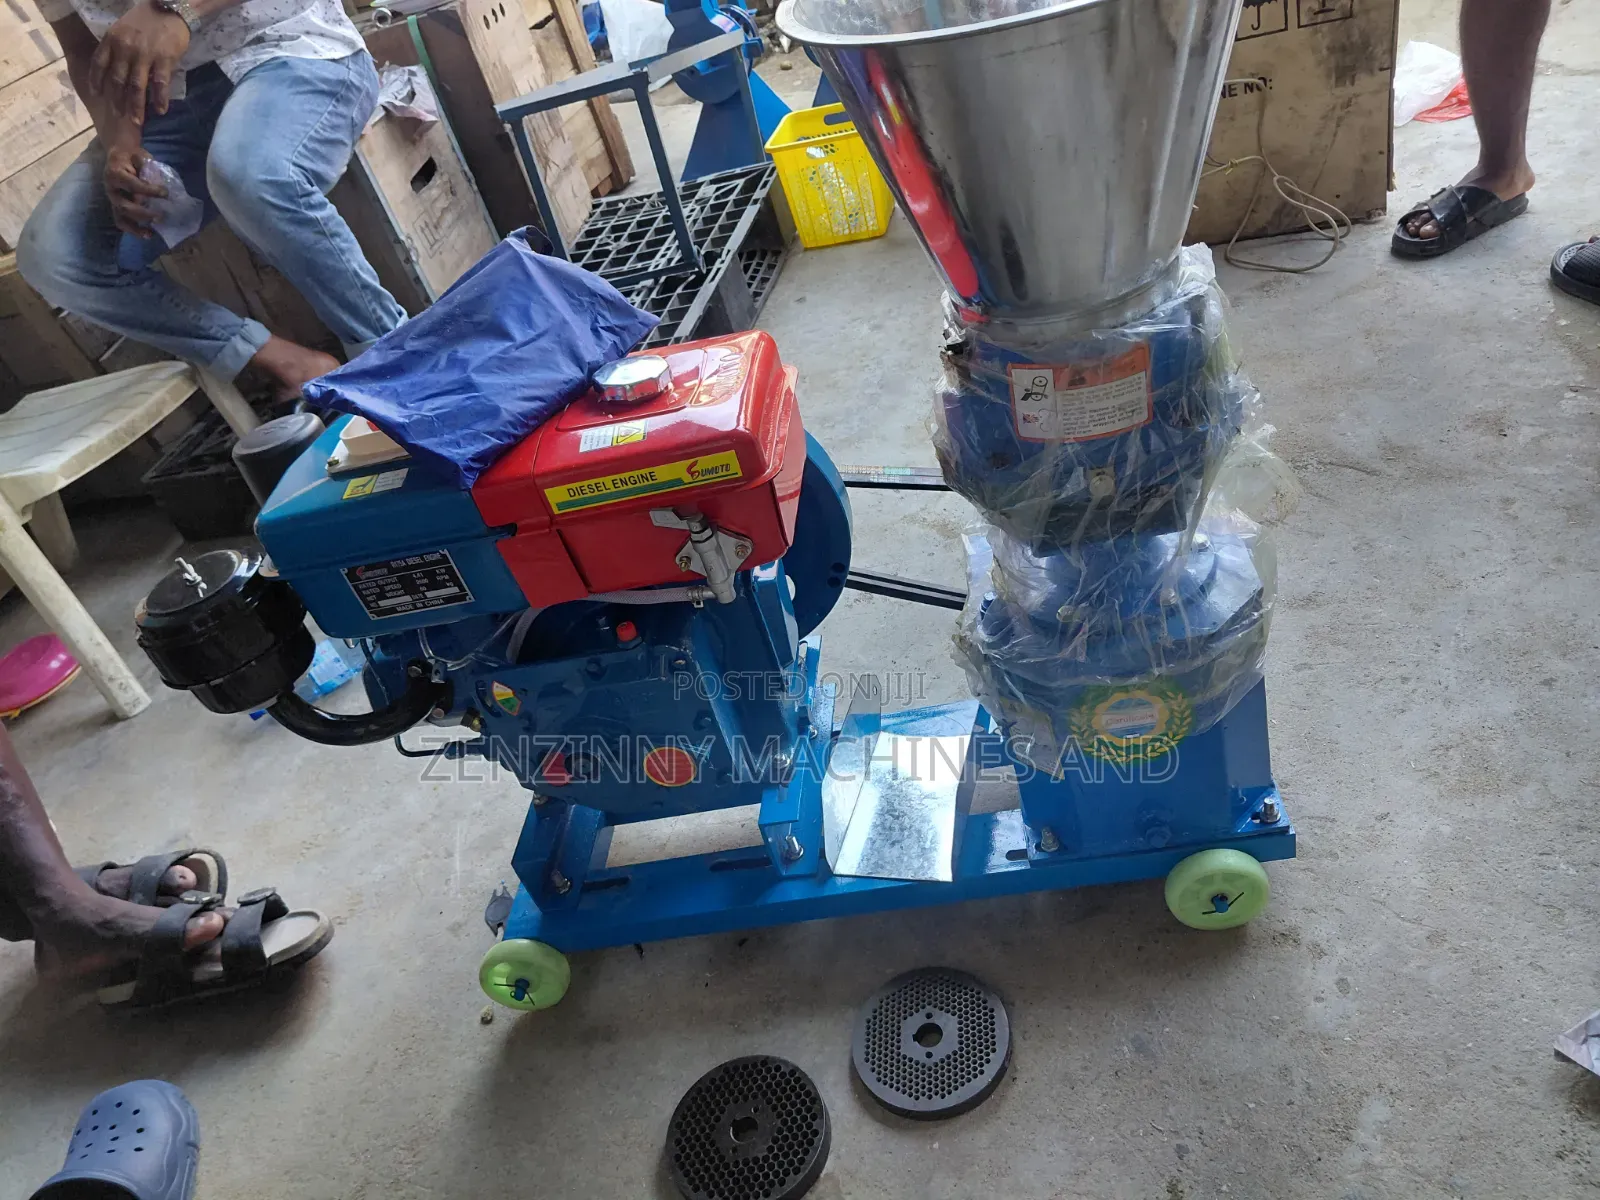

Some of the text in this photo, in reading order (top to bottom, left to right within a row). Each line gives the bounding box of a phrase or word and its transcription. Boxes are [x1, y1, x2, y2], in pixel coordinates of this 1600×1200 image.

[567, 471, 658, 498] DIESEL ENGINE
[396, 604, 414, 612] MADE
[424, 598, 445, 607] CHINA
